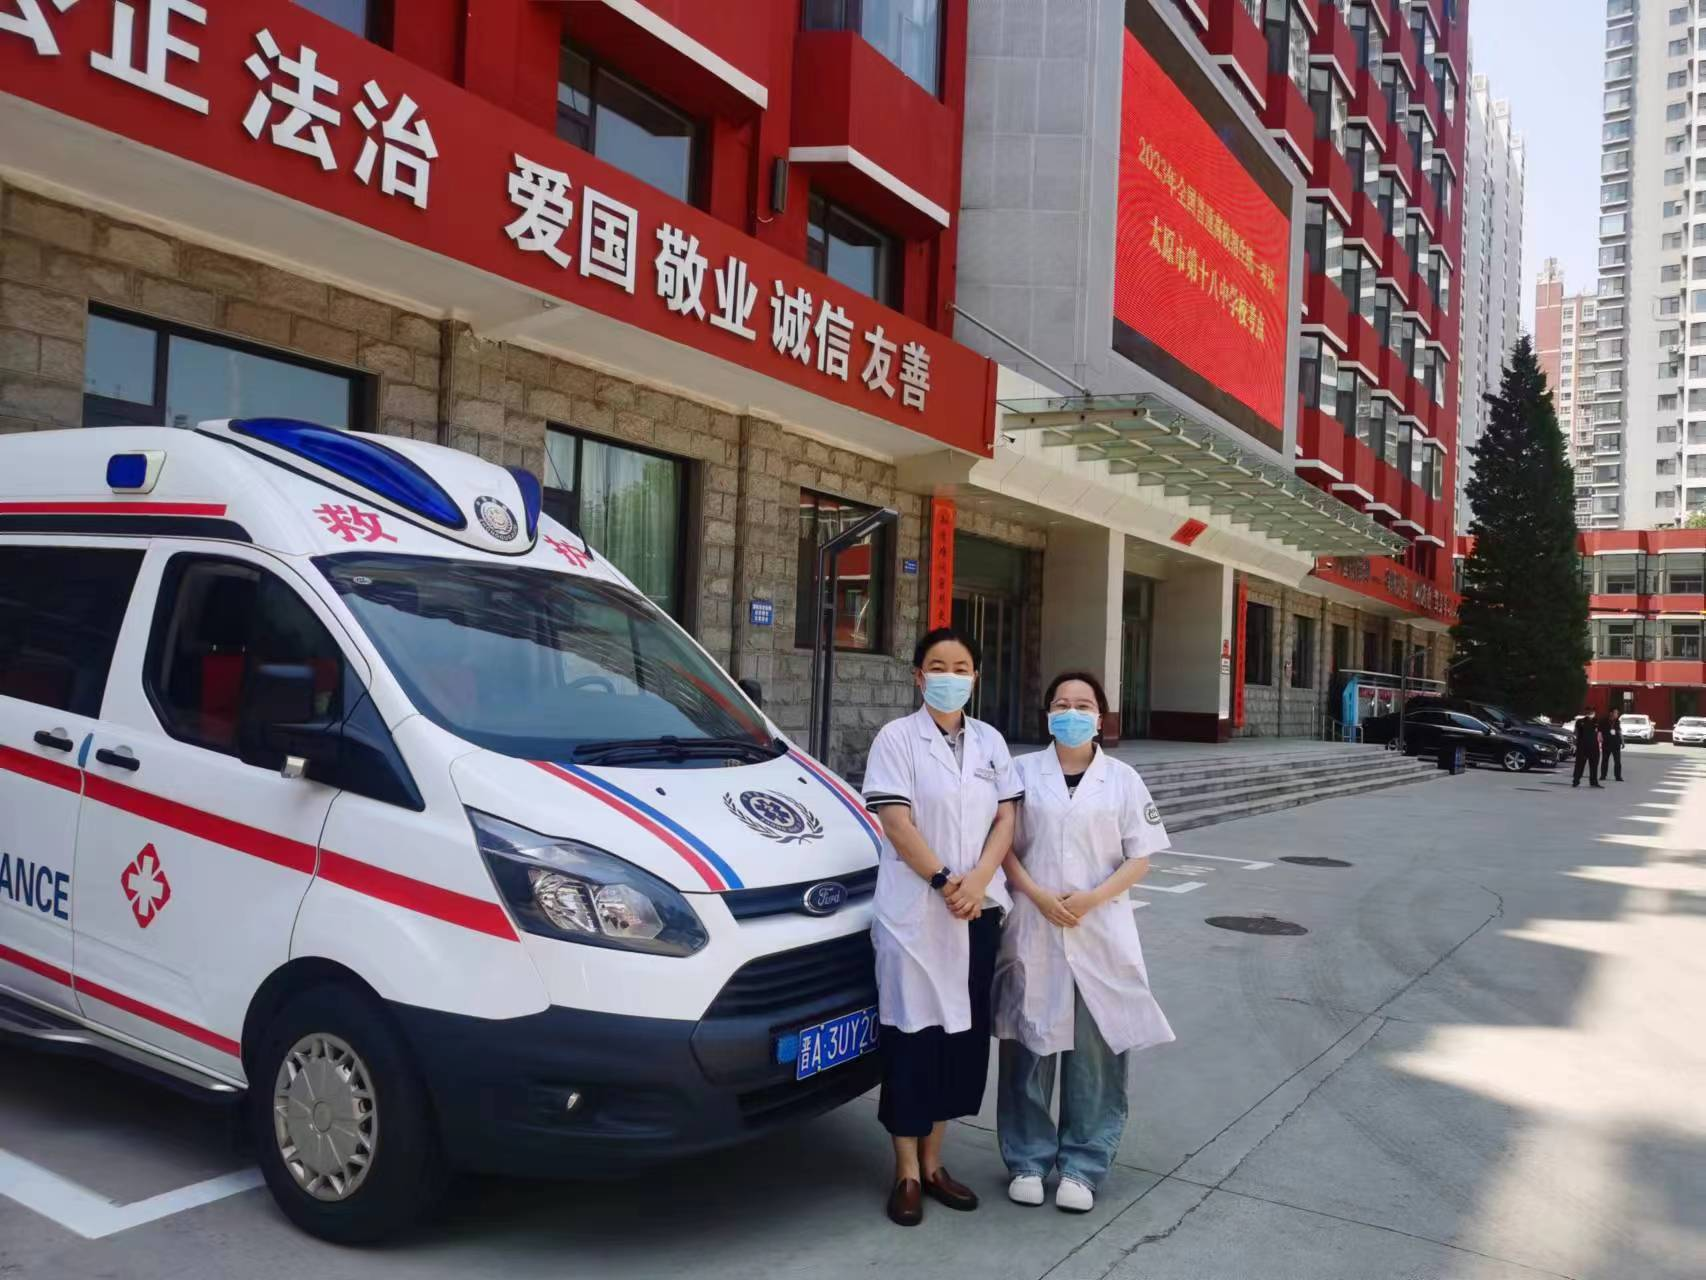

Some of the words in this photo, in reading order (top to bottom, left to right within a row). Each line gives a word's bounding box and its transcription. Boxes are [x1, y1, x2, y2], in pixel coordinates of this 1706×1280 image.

[242, 28, 439, 209] 法治
[504, 153, 639, 294] 爱国
[655, 222, 758, 341] 敬业
[771, 280, 854, 381] 诚信
[861, 326, 930, 411] 友善
[312, 503, 398, 543] 救
[817, 887, 841, 906] Ford
